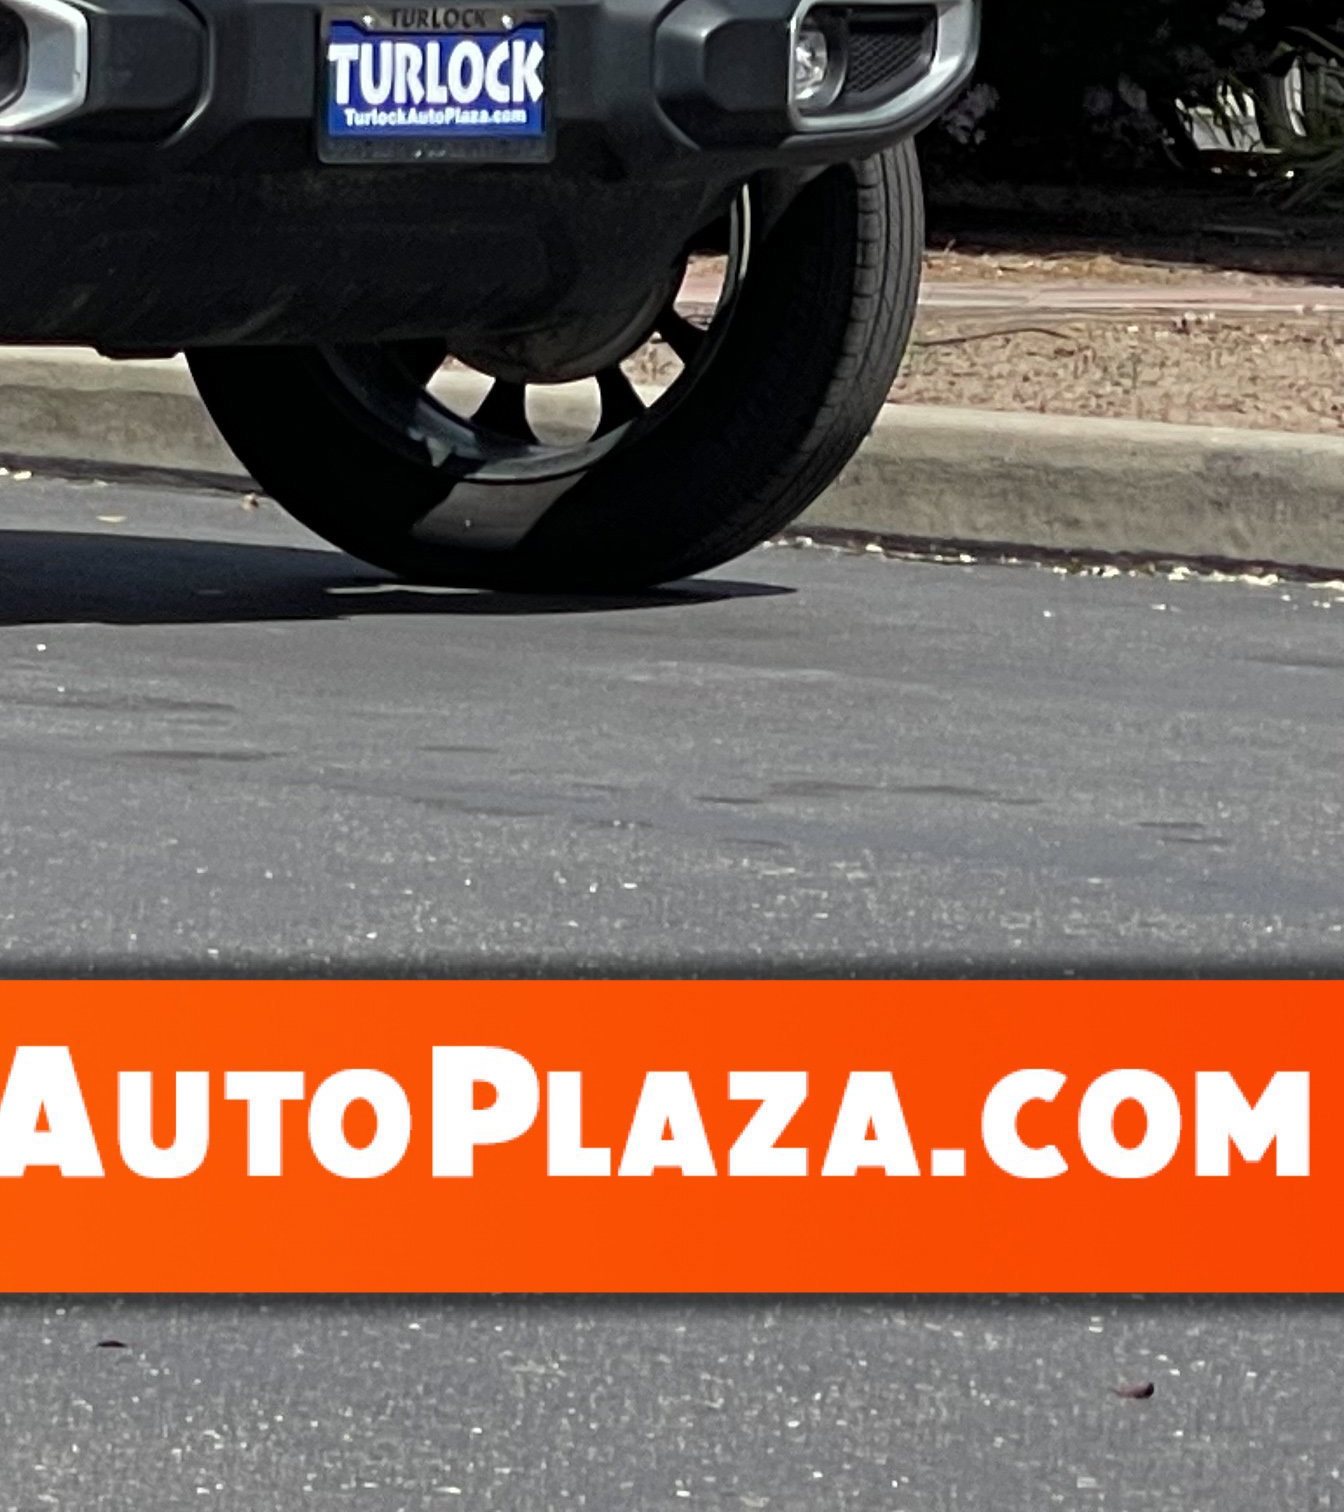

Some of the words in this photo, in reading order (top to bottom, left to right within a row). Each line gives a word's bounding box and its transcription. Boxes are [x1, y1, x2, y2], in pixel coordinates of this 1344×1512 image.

[390, 7, 488, 29] TURLOCK
[327, 39, 545, 106] TURLOCK
[344, 107, 528, 127] TurlockAutoPlaza.com
